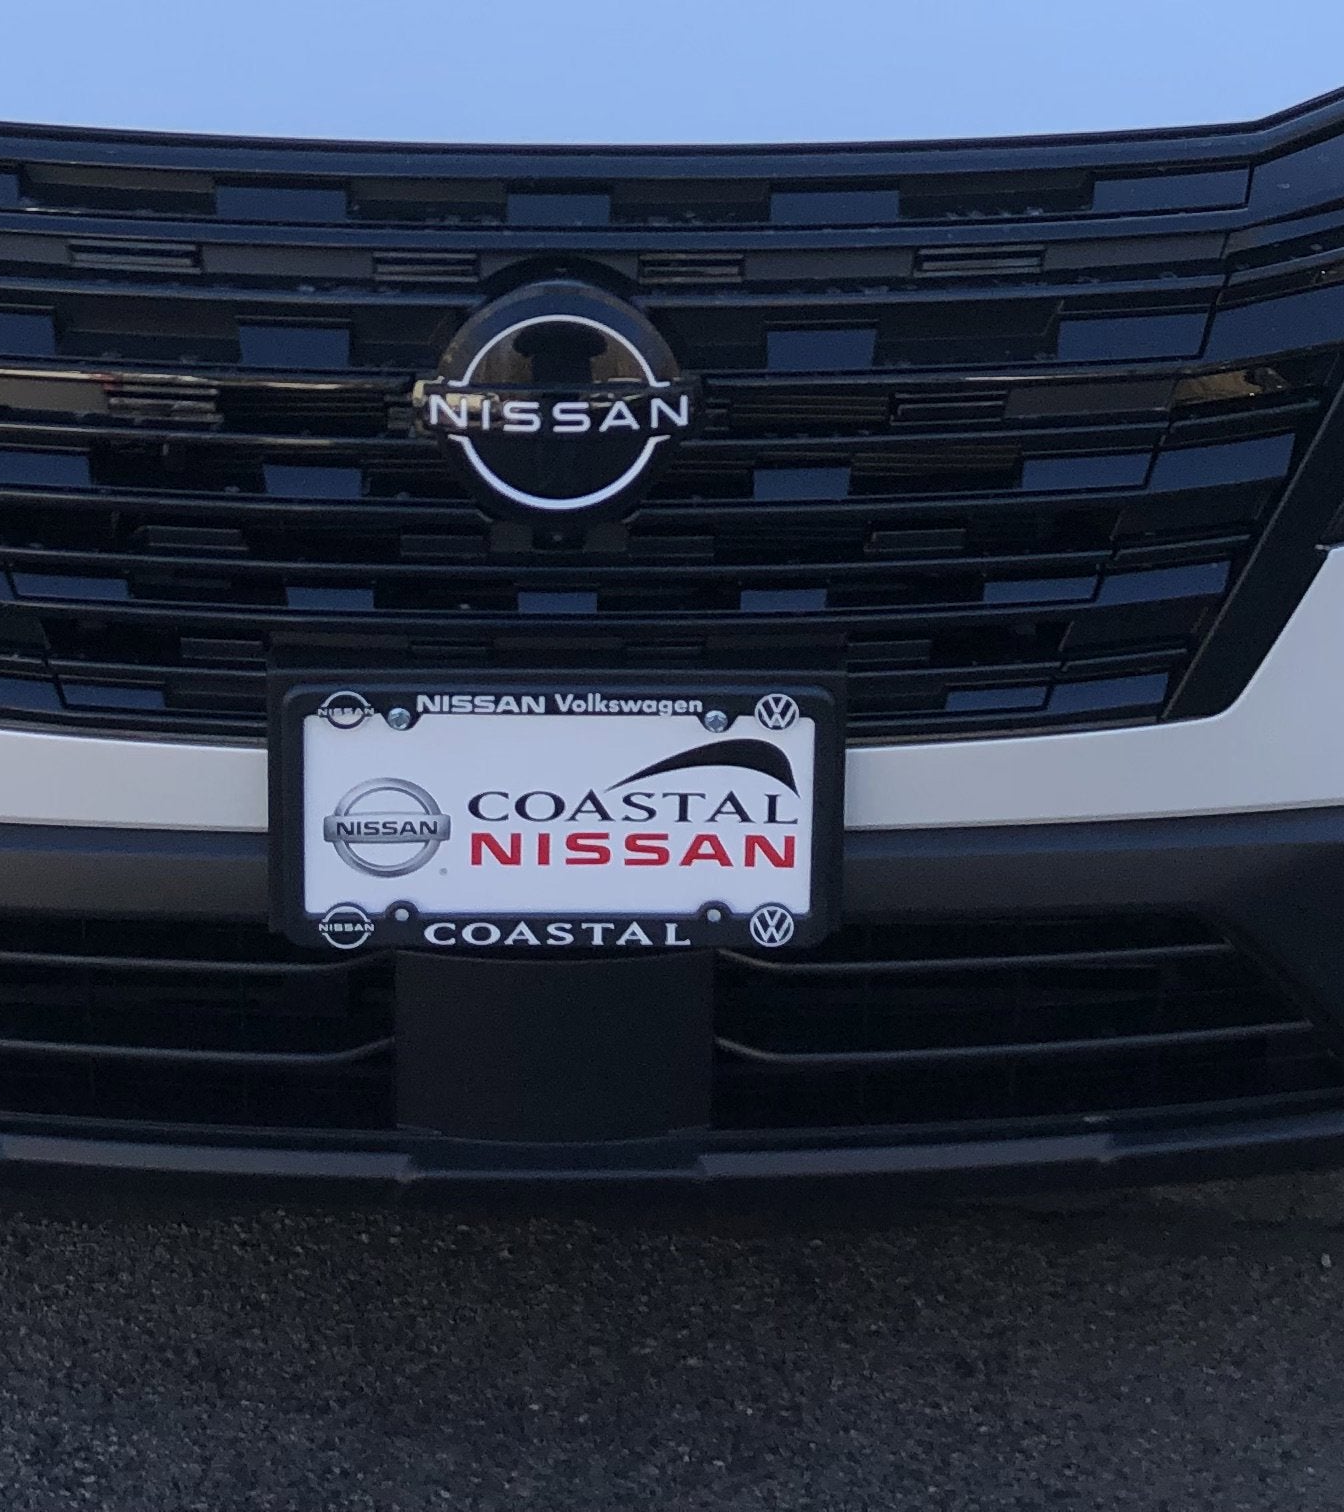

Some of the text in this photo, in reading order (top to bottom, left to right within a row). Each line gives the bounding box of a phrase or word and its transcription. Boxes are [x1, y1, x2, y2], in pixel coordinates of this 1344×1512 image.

[428, 394, 689, 433] NISSAN
[416, 693, 703, 716] NISSAN Volkswagen
[467, 788, 799, 825] COASTAL
[336, 820, 438, 836] NISSAN
[470, 832, 796, 869] NISSAN
[423, 920, 691, 946] COASTAL
